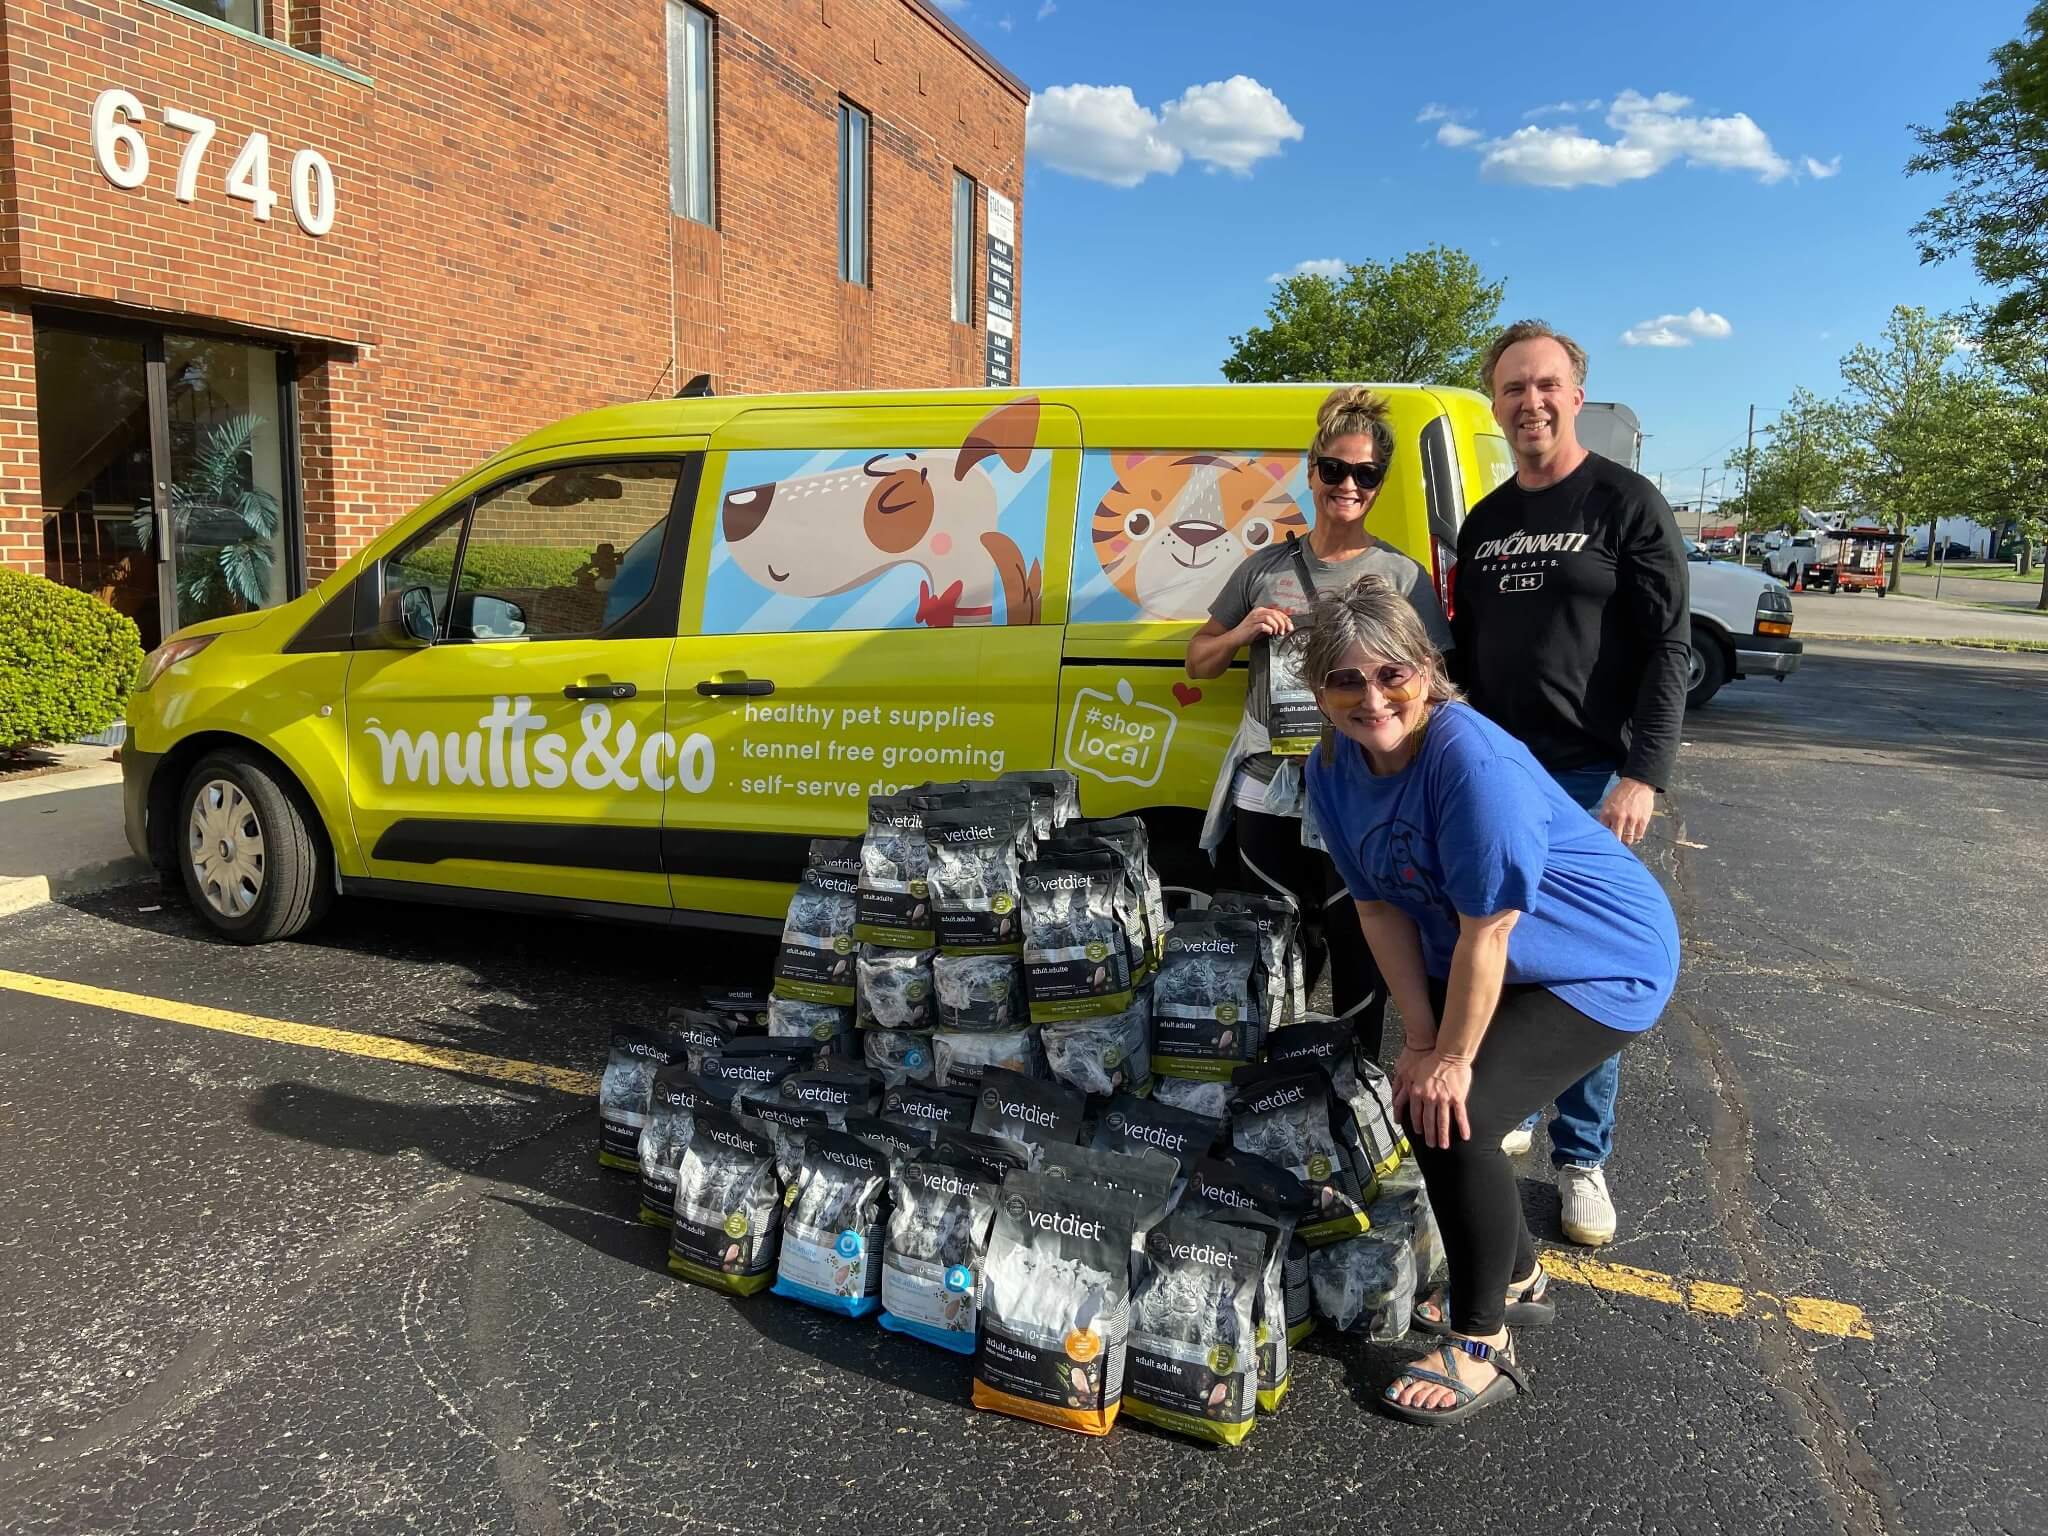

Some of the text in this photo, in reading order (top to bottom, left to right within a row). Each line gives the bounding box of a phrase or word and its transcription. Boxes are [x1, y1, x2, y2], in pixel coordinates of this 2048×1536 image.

[91, 88, 336, 236] 6740
[1474, 530, 1591, 560] CINCINNATI
[1482, 560, 1556, 572] BEARCATS
[745, 703, 995, 732] healthy pet supplies
[1084, 706, 1156, 742] #shop
[364, 695, 715, 794] mutts&co
[742, 739, 1005, 770] kennel free grooming
[1078, 729, 1150, 769] local
[740, 774, 916, 798] self-serve do
[944, 826, 995, 843] vetdiet
[818, 877, 858, 894] vetdie
[1040, 875, 1093, 892] vetdiet
[1182, 939, 1235, 954] vetdiet
[721, 1065, 772, 1082] vetdiet
[796, 1088, 848, 1104] vetdiet
[1252, 1086, 1303, 1114] vetdiet
[757, 1108, 805, 1128] vetdiet
[901, 1102, 949, 1121] vetdiet
[1000, 1100, 1056, 1129] vetdiet
[711, 1129, 756, 1154] vetdiet
[1124, 1120, 1183, 1152] vetdiet
[823, 1149, 873, 1172] vetdiet
[922, 1174, 976, 1199] vetdiet
[1028, 1210, 1101, 1242] vetdiet
[1169, 1241, 1234, 1269] vetdiet
